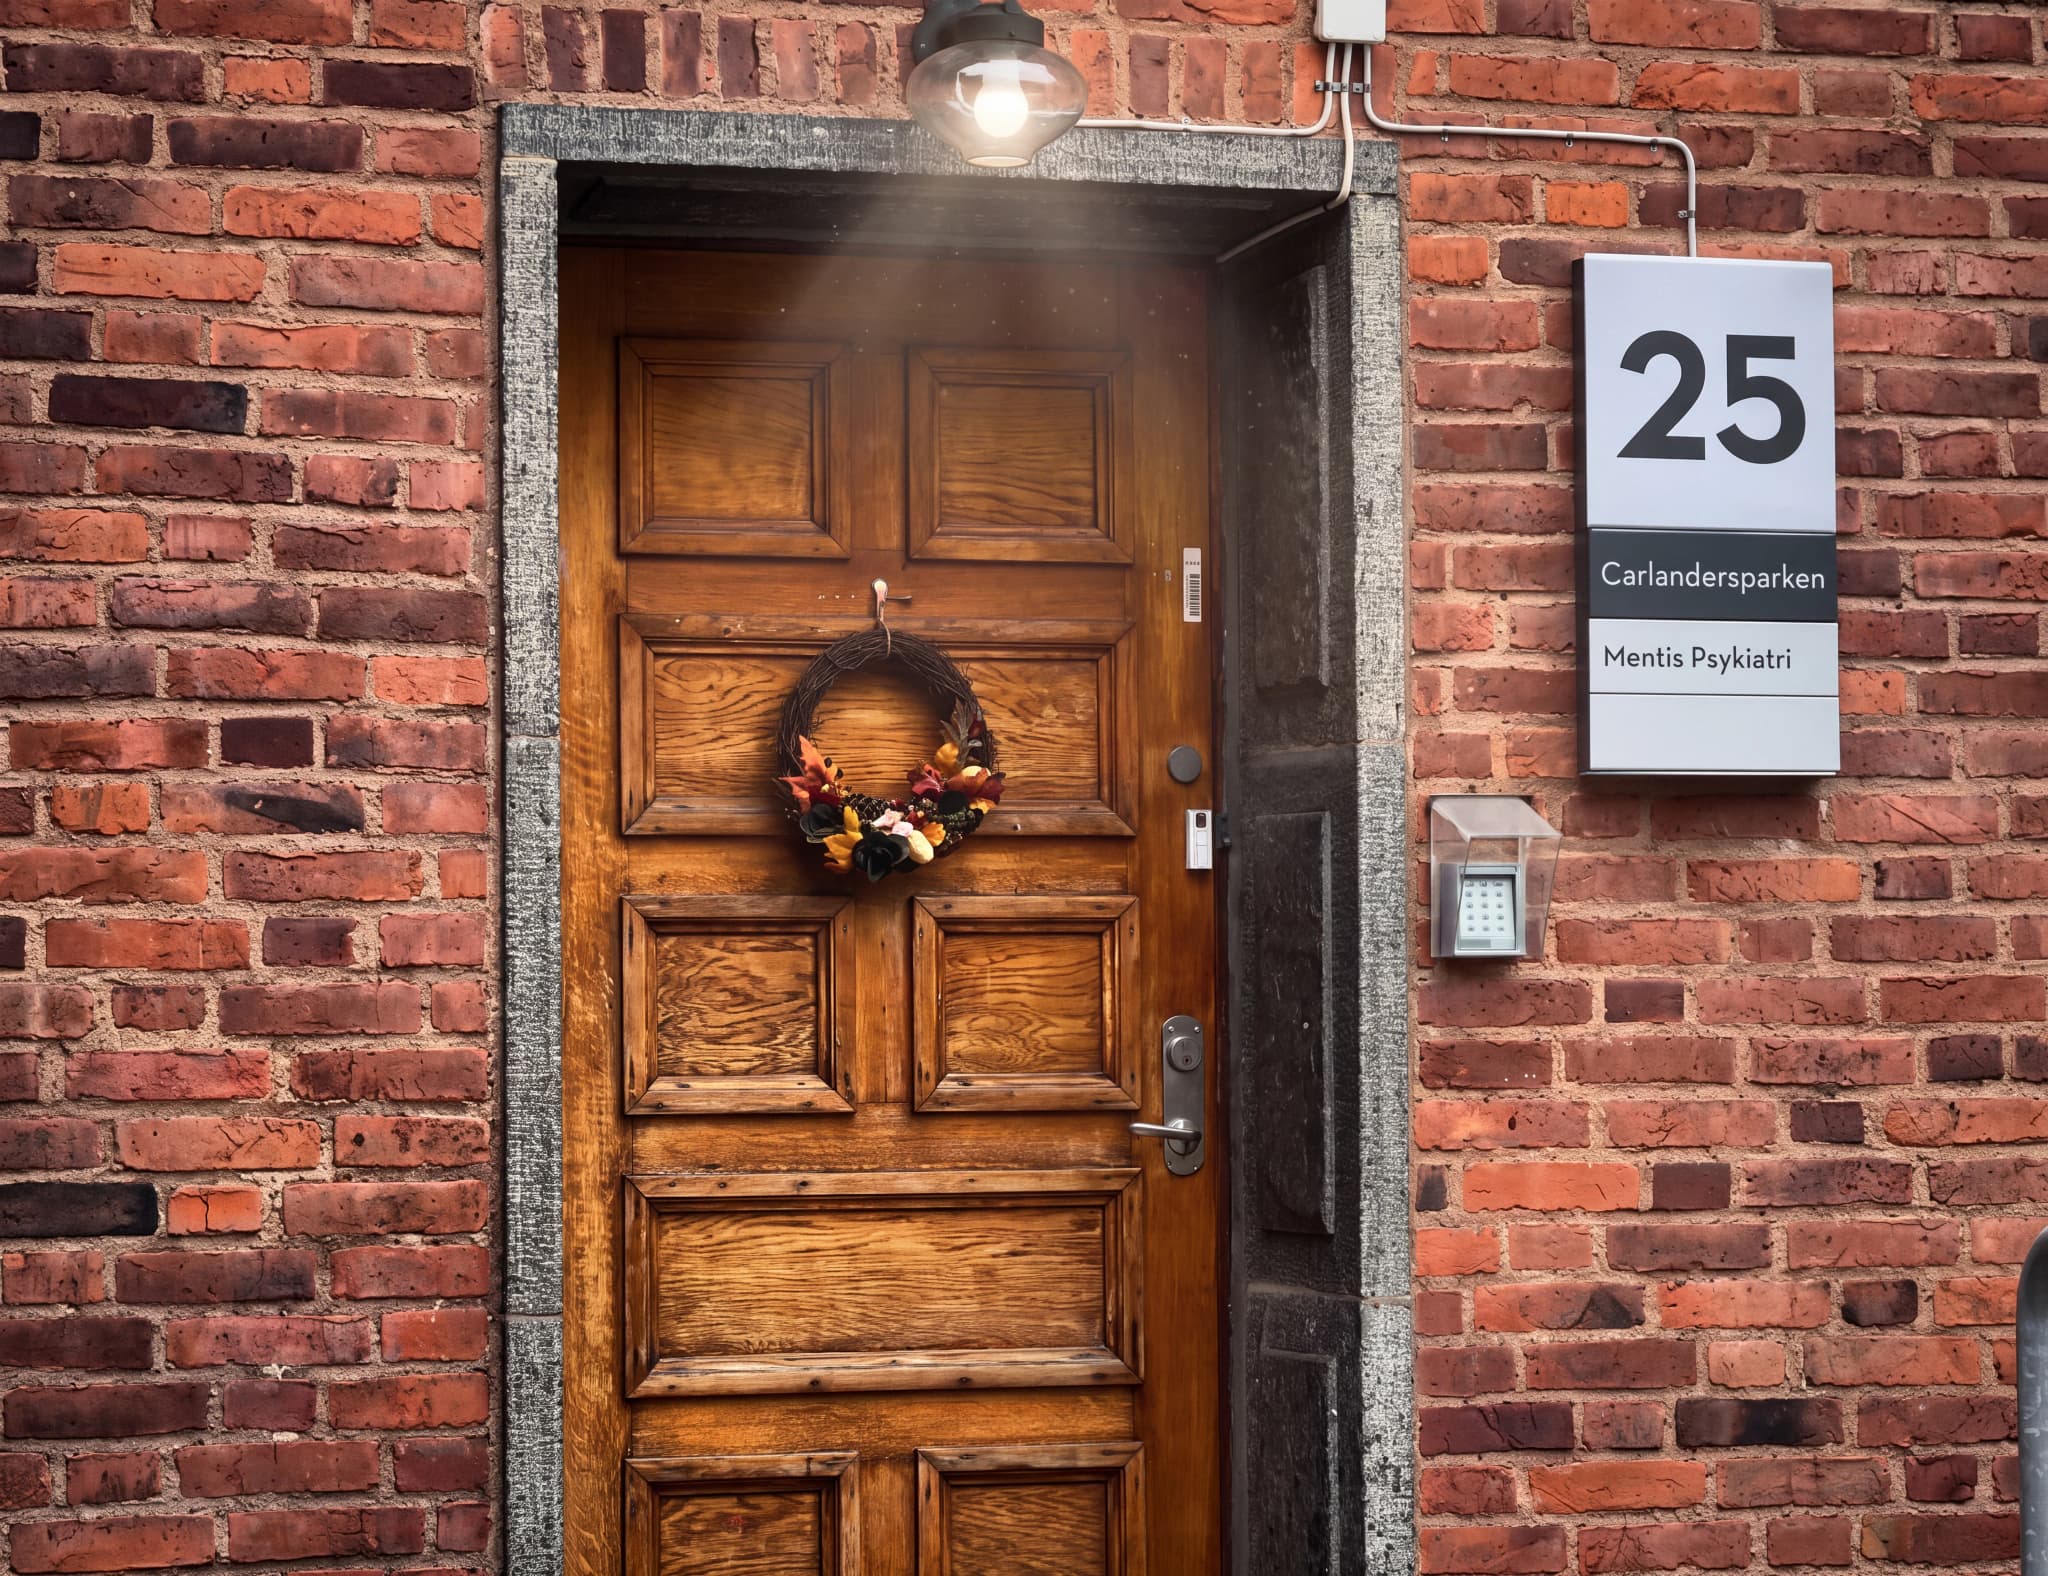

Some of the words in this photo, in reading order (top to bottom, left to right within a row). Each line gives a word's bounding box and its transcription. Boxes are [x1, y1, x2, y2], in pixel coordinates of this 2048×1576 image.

[1616, 329, 1806, 464] 25
[1601, 561, 1825, 594] Carlandersparken
[1604, 645, 1683, 669] Mentis
[1692, 646, 1792, 675] Psykiatri
